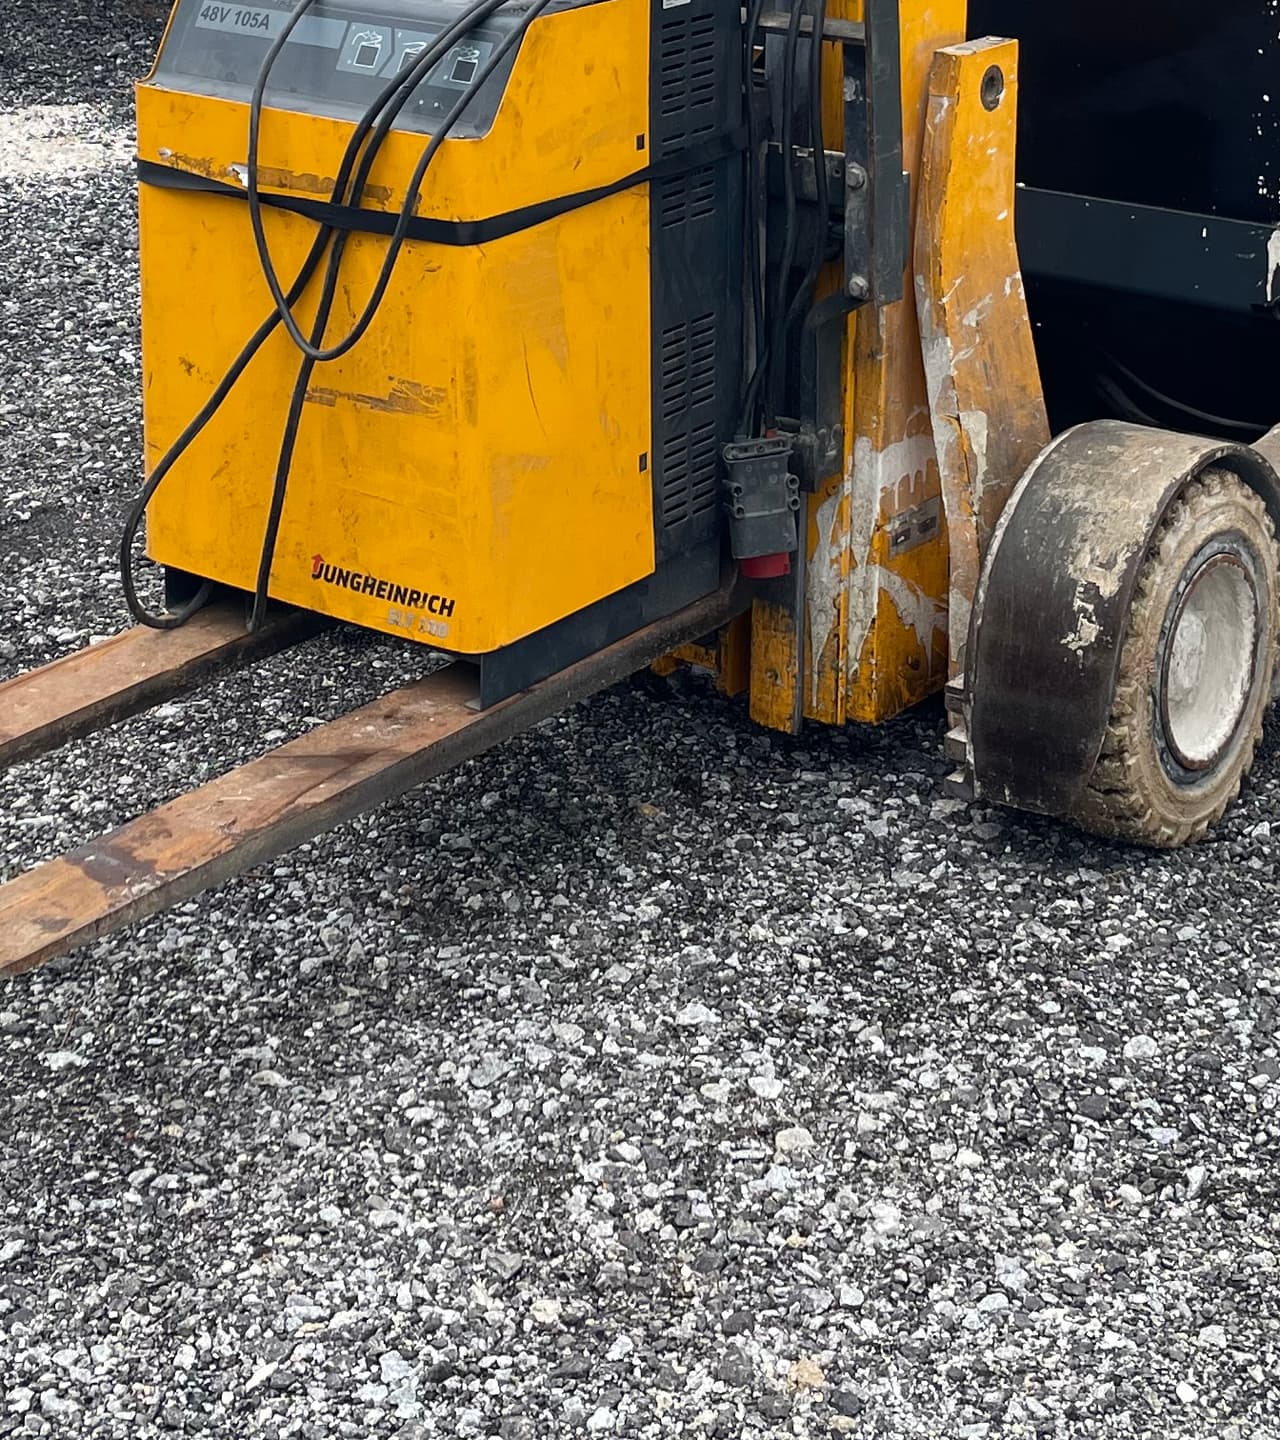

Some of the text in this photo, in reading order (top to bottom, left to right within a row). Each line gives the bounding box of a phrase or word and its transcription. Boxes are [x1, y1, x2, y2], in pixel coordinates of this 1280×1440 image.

[200, 5, 271, 30] 48V 105A
[311, 553, 455, 617] JUNGHEINRICH
